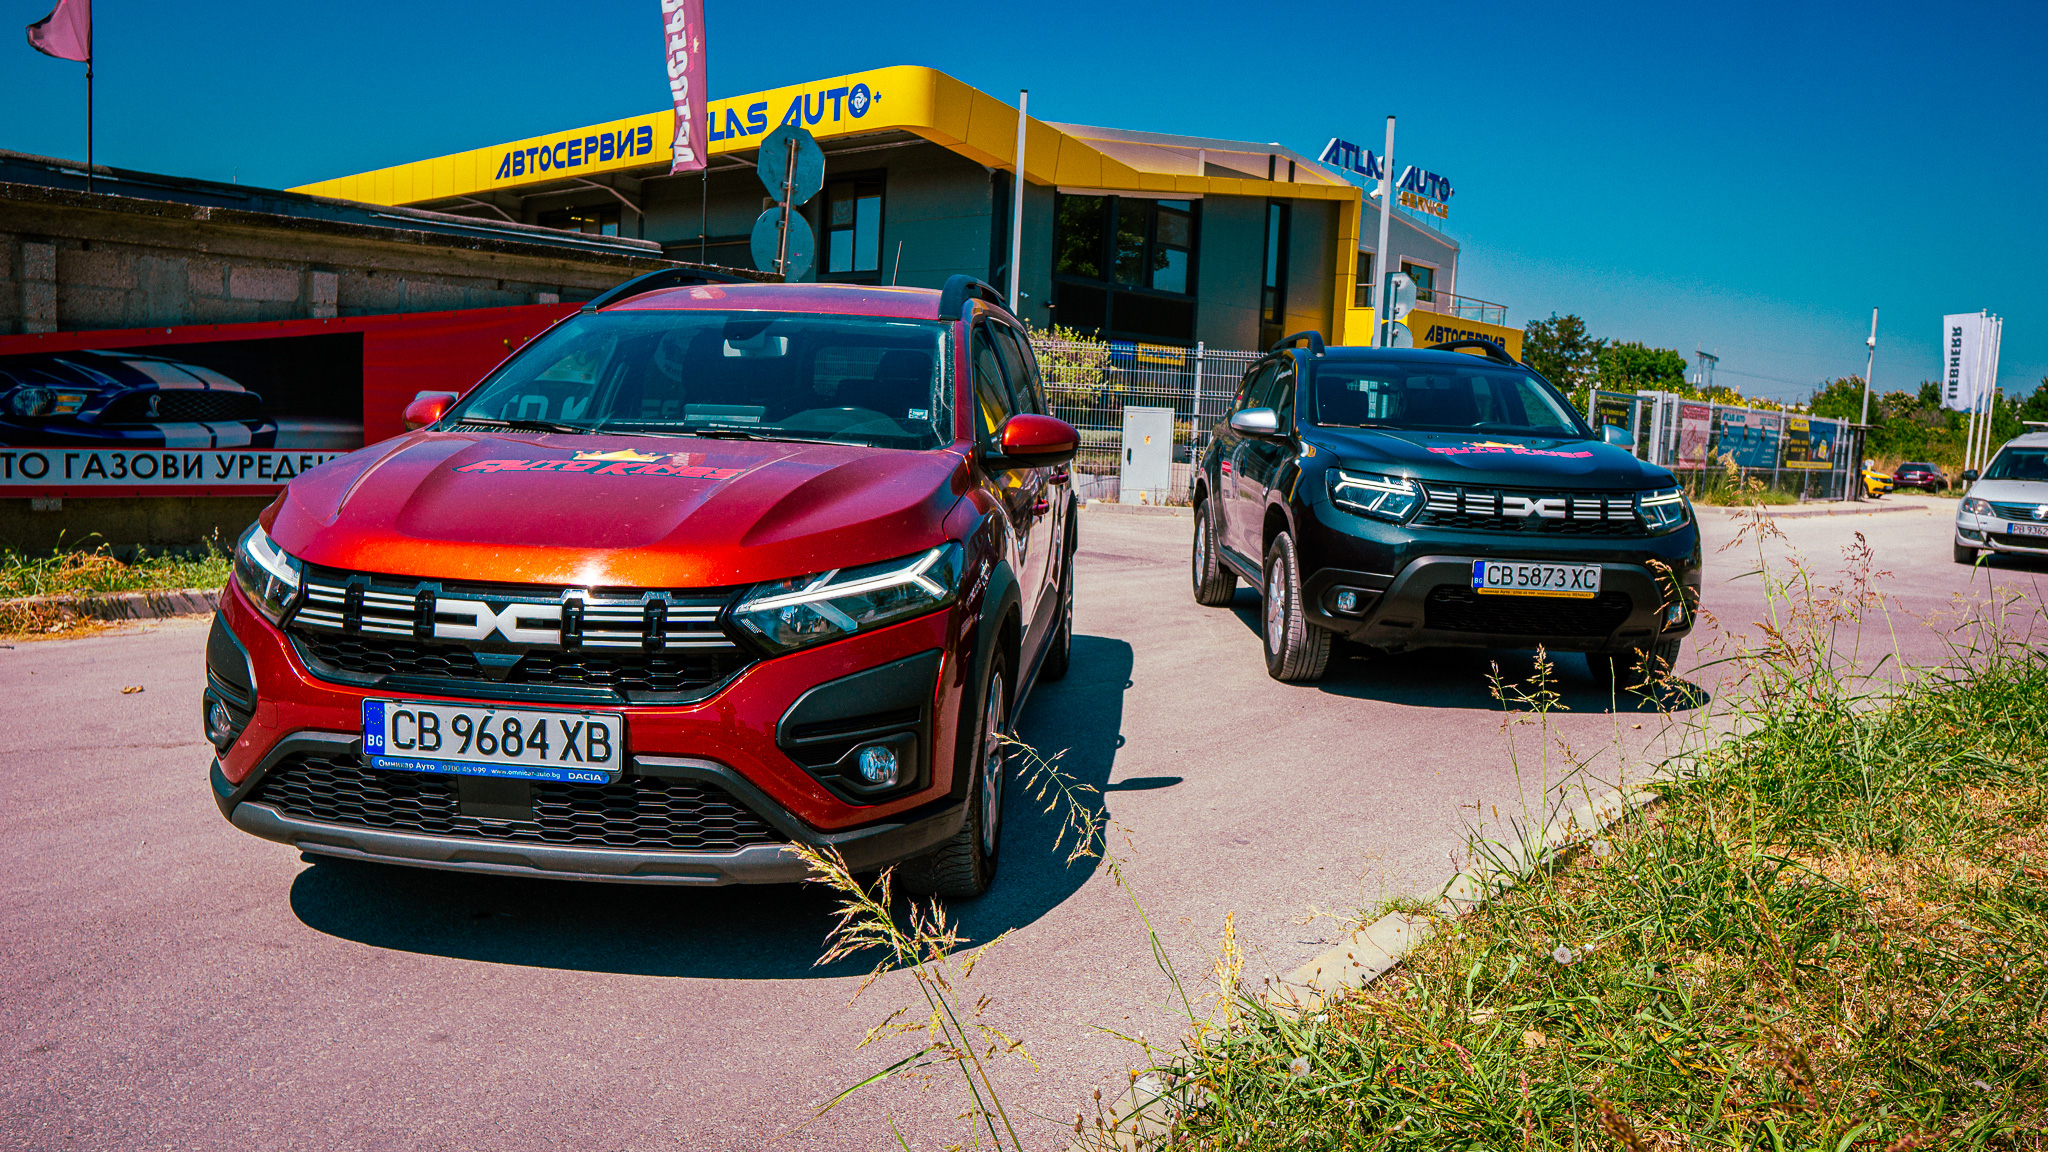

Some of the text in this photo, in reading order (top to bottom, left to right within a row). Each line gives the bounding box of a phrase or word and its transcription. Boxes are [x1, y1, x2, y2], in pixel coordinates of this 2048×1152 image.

[495, 125, 653, 180] АВТОСЕРВИЗ
[1400, 191, 1449, 219] SERVICE
[64, 453, 204, 481] ГАЗОВИ
[214, 454, 336, 482] УРЕДБ
[454, 460, 749, 480] AUTO KINGS
[1487, 565, 1597, 589] CB 5873 XC
[367, 734, 383, 747] BG
[391, 710, 611, 763] CB 9684 XB
[378, 759, 413, 770] Омникар
[416, 762, 436, 771] Ауто
[490, 768, 561, 780] www.omnicar-auto.bg
[568, 772, 602, 782] DACIA
